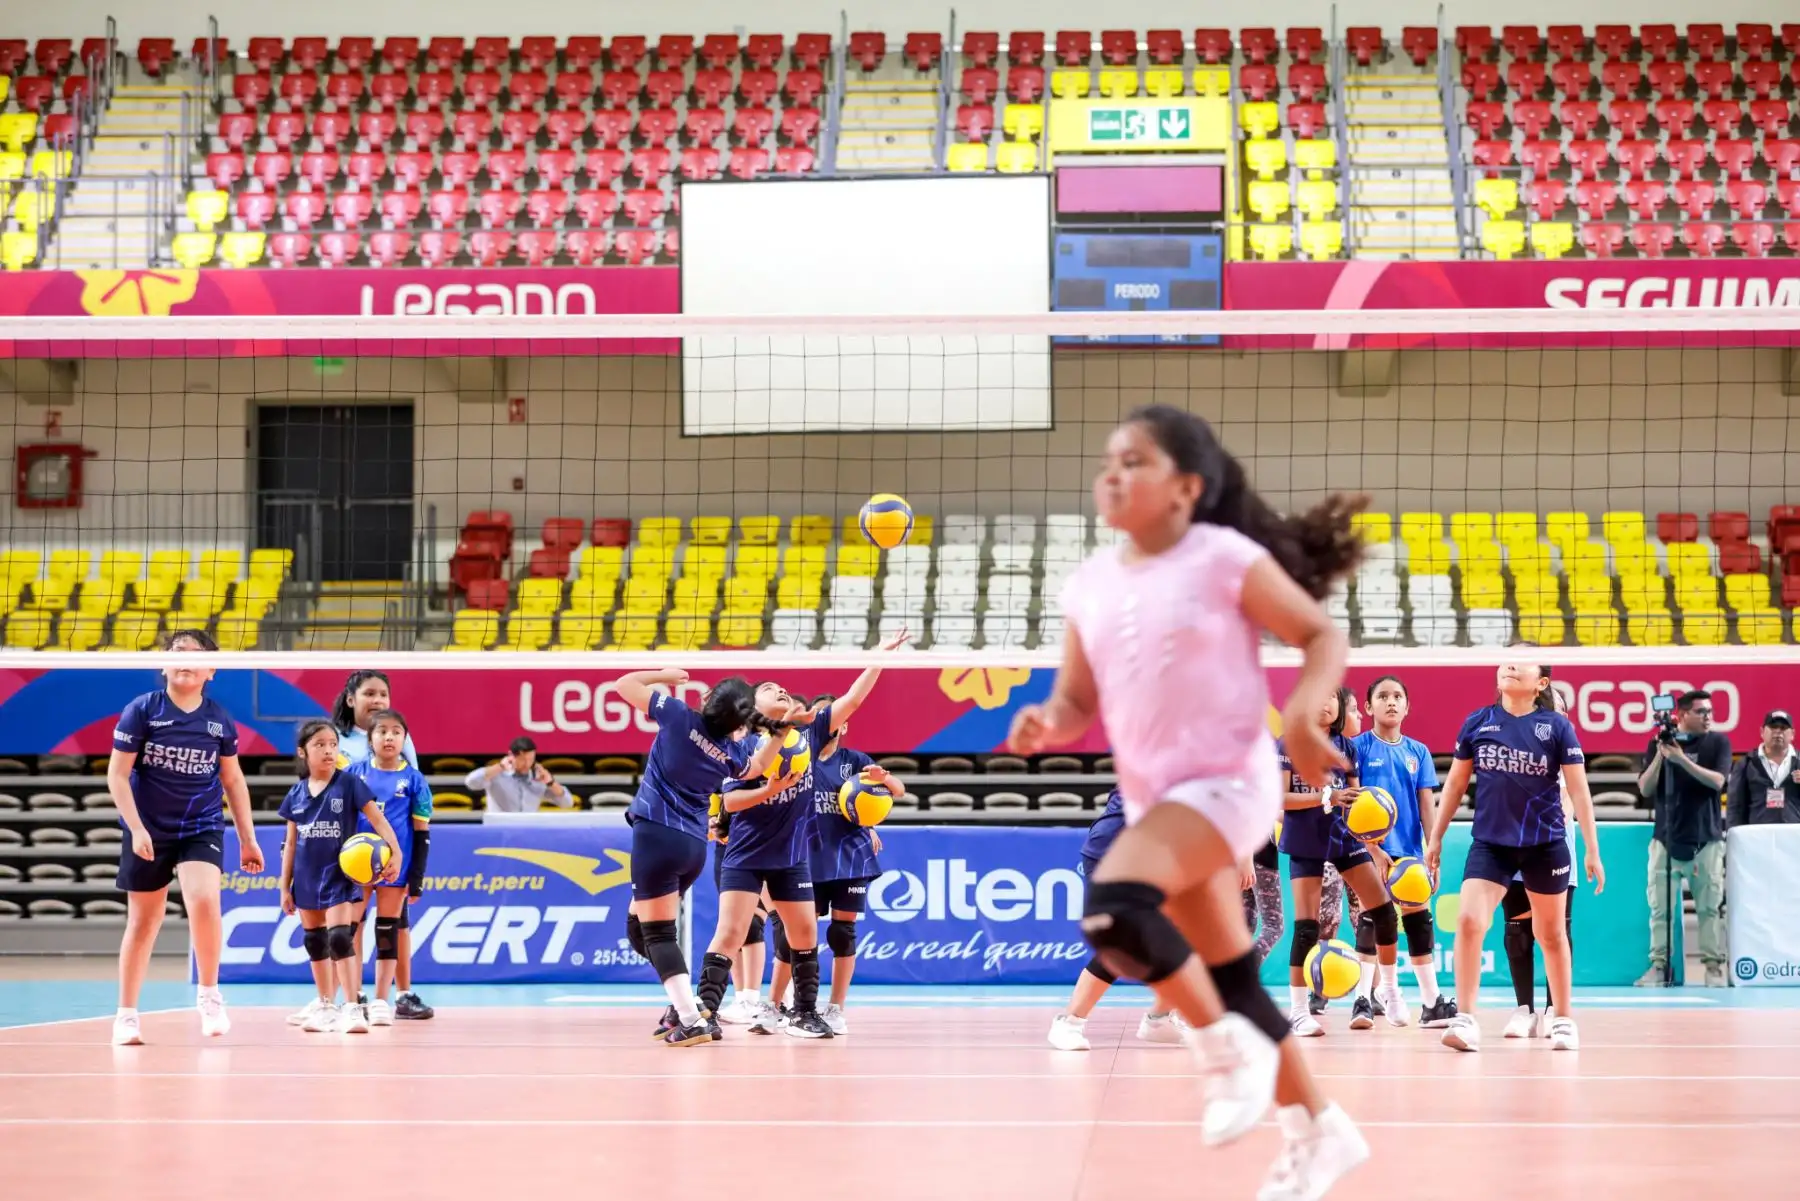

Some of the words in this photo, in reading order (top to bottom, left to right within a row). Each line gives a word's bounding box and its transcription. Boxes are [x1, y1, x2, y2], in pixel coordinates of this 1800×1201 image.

[1114, 284, 1160, 299] PERIODO
[519, 680, 711, 733] LEGD
[113, 729, 133, 744] BK
[144, 741, 217, 764] ESCUELA
[1478, 744, 1548, 768] ESCUELA
[302, 829, 341, 838] ARICIO
[421, 873, 545, 895] nvert.peru
[818, 858, 1085, 922] olten
[855, 931, 899, 960] he
[902, 930, 983, 960] real
[983, 942, 1088, 971] game
[1763, 960, 1800, 980] @dr
